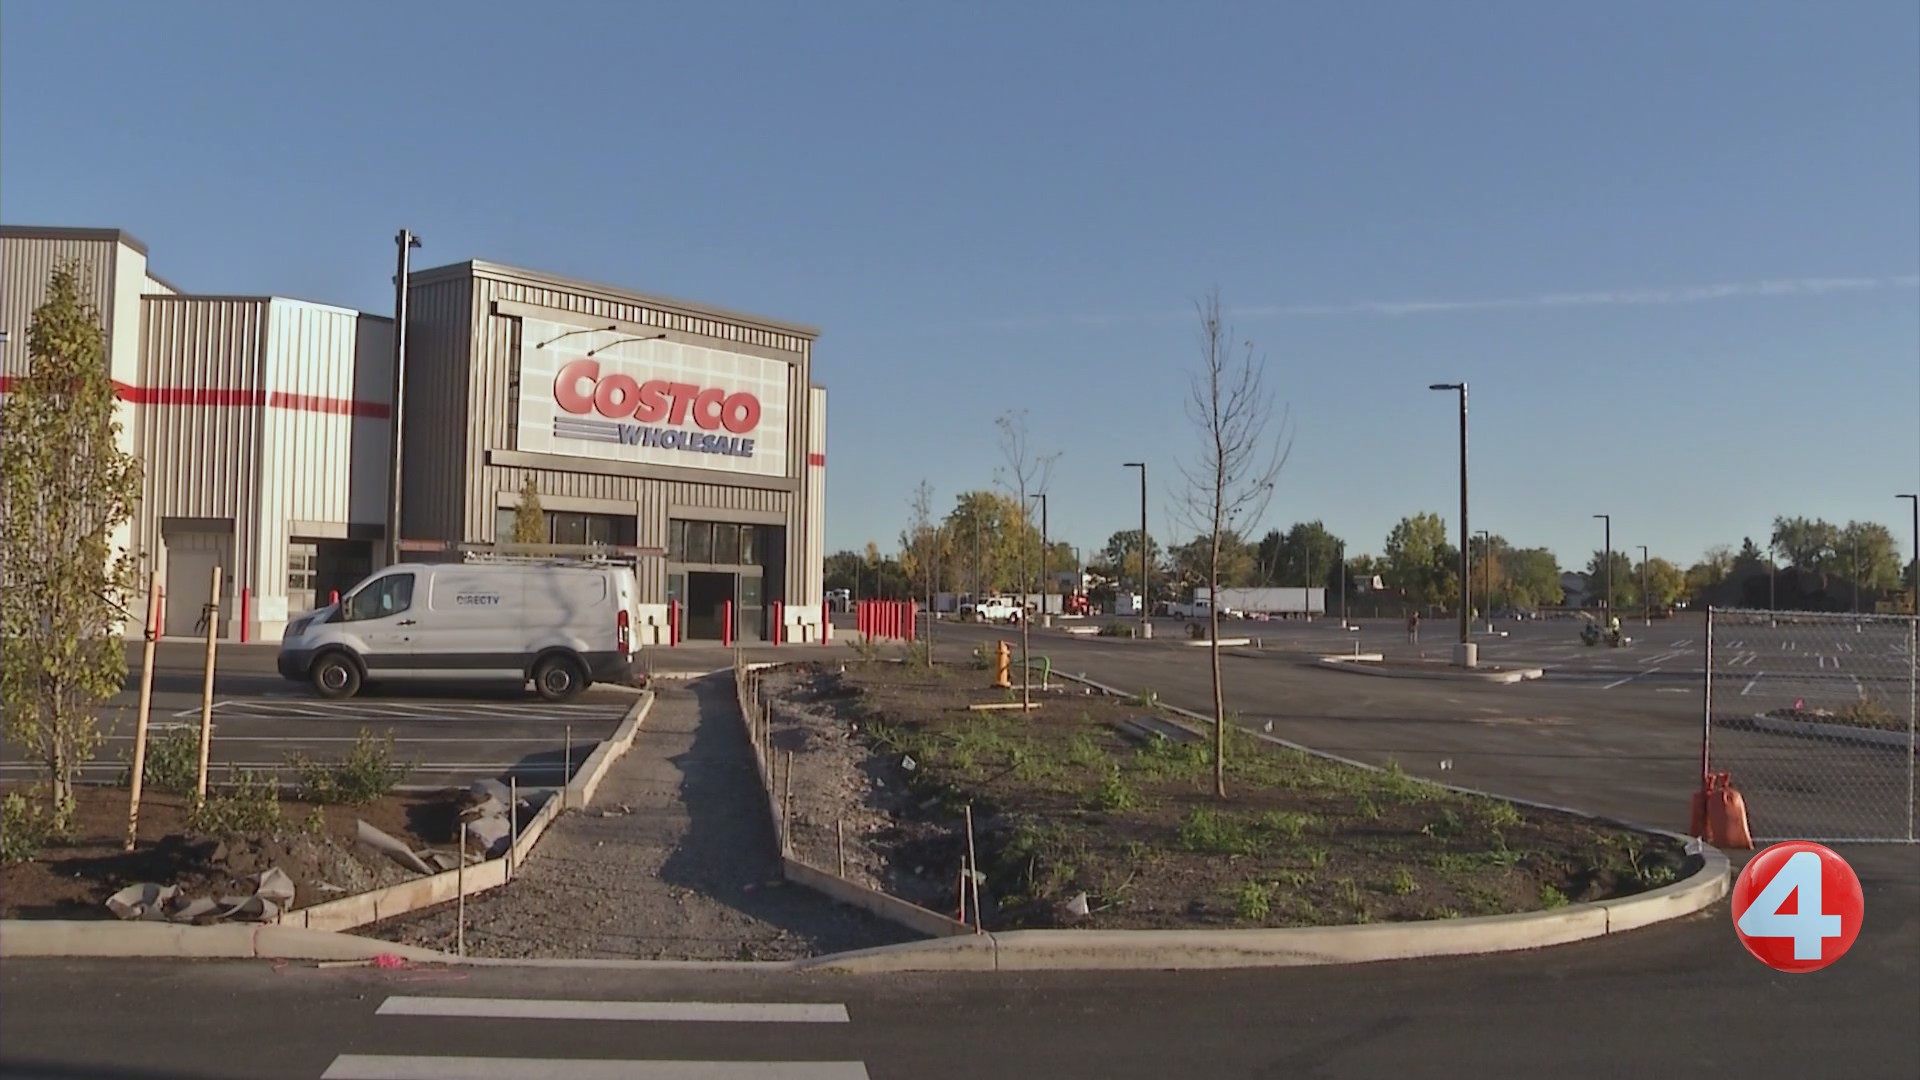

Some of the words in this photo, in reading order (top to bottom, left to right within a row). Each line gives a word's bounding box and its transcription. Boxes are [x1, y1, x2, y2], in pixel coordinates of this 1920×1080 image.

[554, 359, 761, 433] COSTCO
[618, 424, 755, 458] WHOLESALE
[456, 595, 500, 605] DIRECTV
